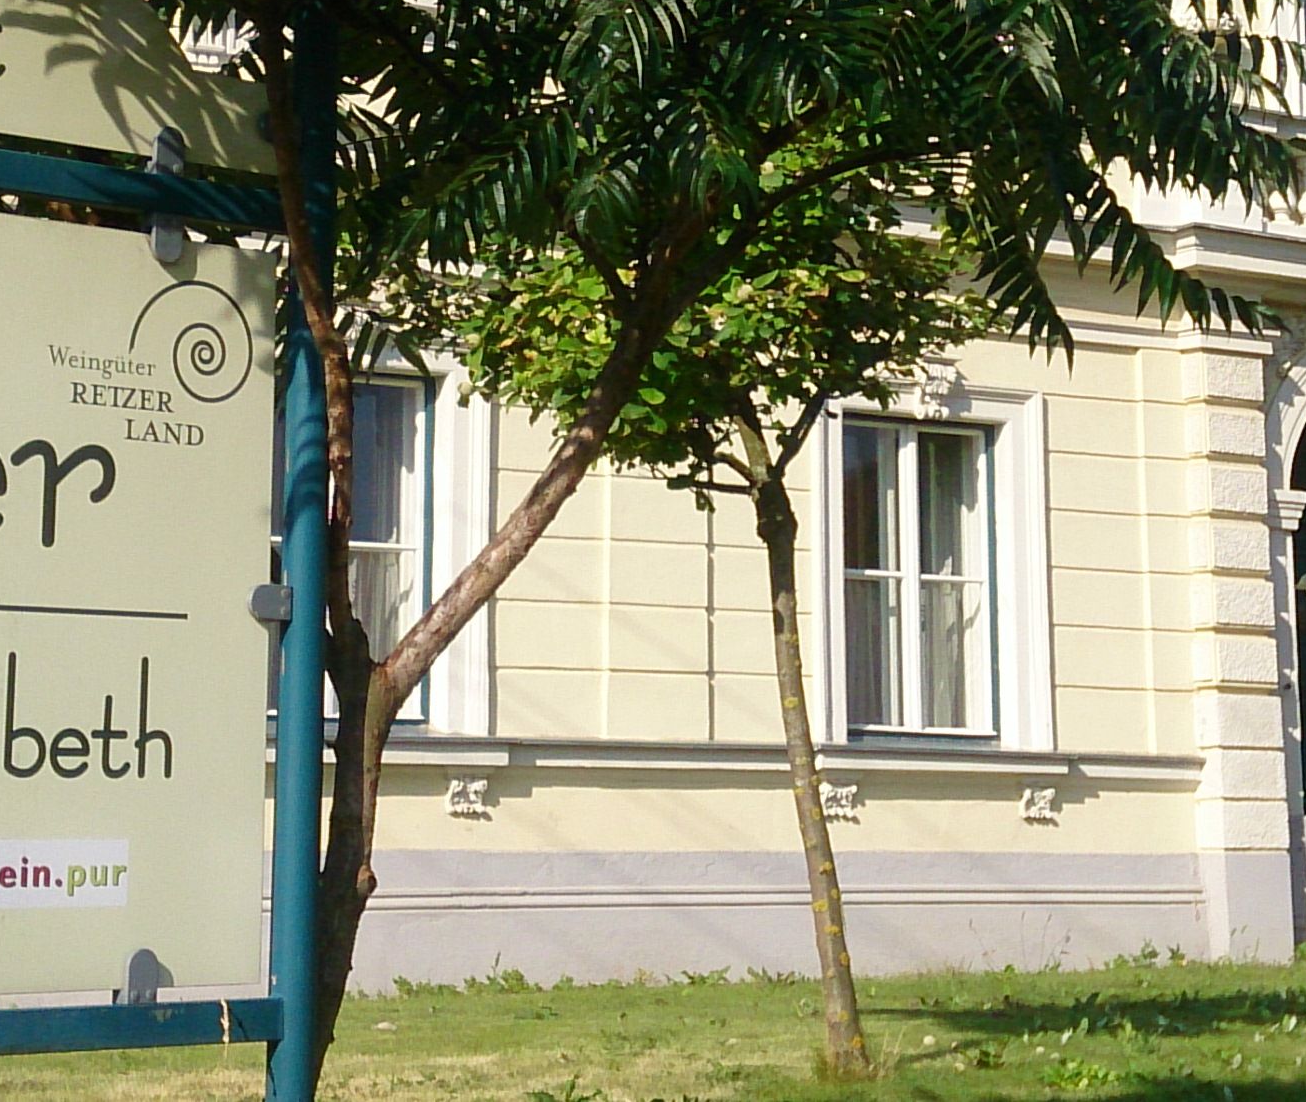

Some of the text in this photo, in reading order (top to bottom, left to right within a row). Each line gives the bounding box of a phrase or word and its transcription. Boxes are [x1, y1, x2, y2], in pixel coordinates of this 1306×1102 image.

[47, 344, 156, 380] Weingüter
[69, 381, 175, 414] RETZER
[124, 418, 205, 447] LAND
